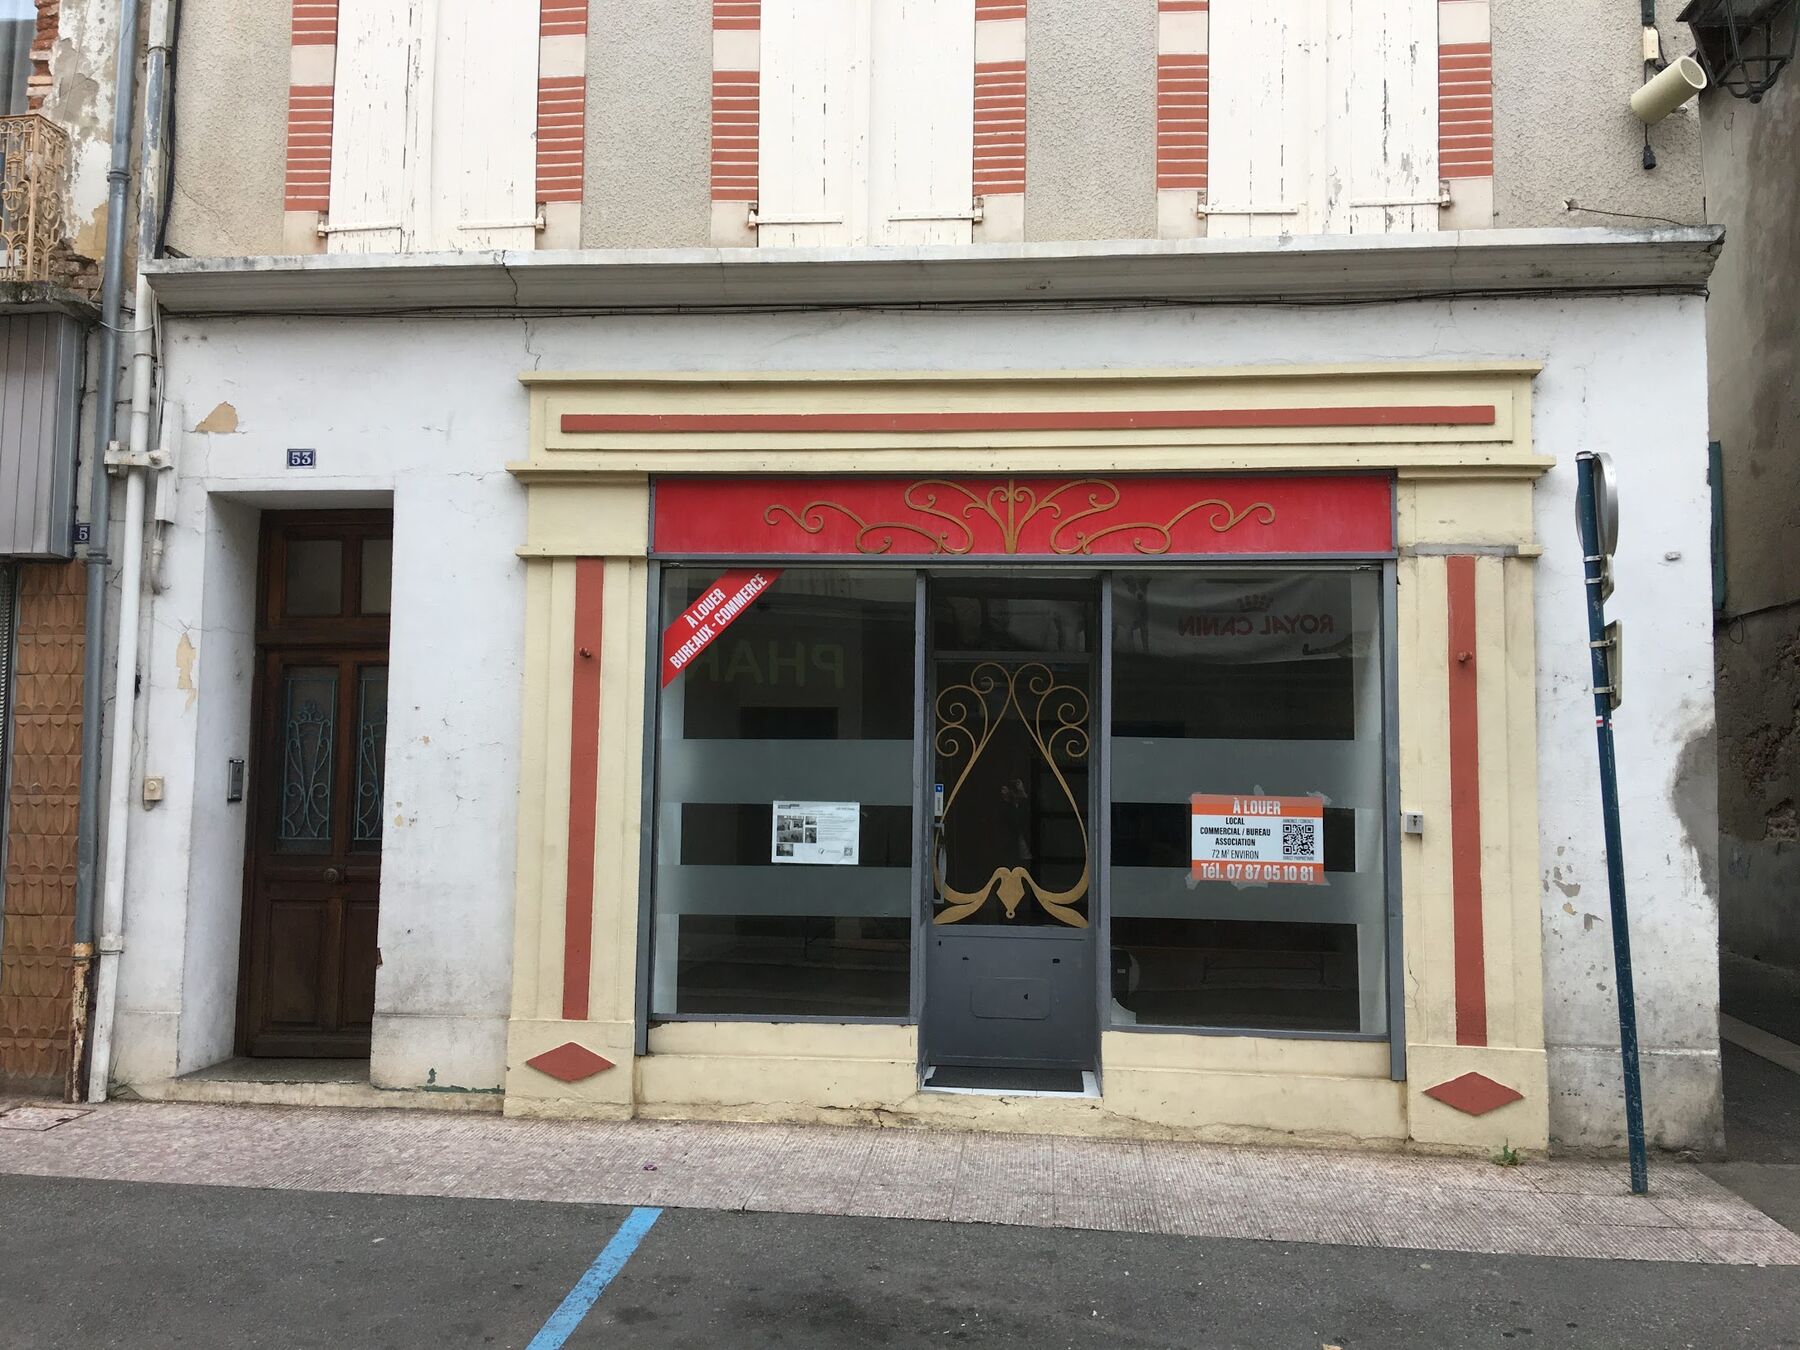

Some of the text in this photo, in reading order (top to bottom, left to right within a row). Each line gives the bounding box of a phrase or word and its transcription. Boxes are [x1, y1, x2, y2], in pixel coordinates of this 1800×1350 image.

[291, 451, 312, 466] 53
[683, 588, 727, 629] À LOUER
[669, 623, 716, 669] BUREAUX
[713, 573, 768, 627] COMMERCE
[1232, 797, 1281, 815] À LOUER
[1225, 816, 1245, 825] LOCAL
[1200, 826, 1241, 836] COMMERCIAL
[1246, 828, 1271, 836] BUREAU
[1215, 837, 1256, 846] ASSOCIATION
[1212, 849, 1220, 859] 72
[1231, 850, 1259, 860] ENVIRON
[1200, 862, 1314, 882] Tél. 07 87 05 10 81
